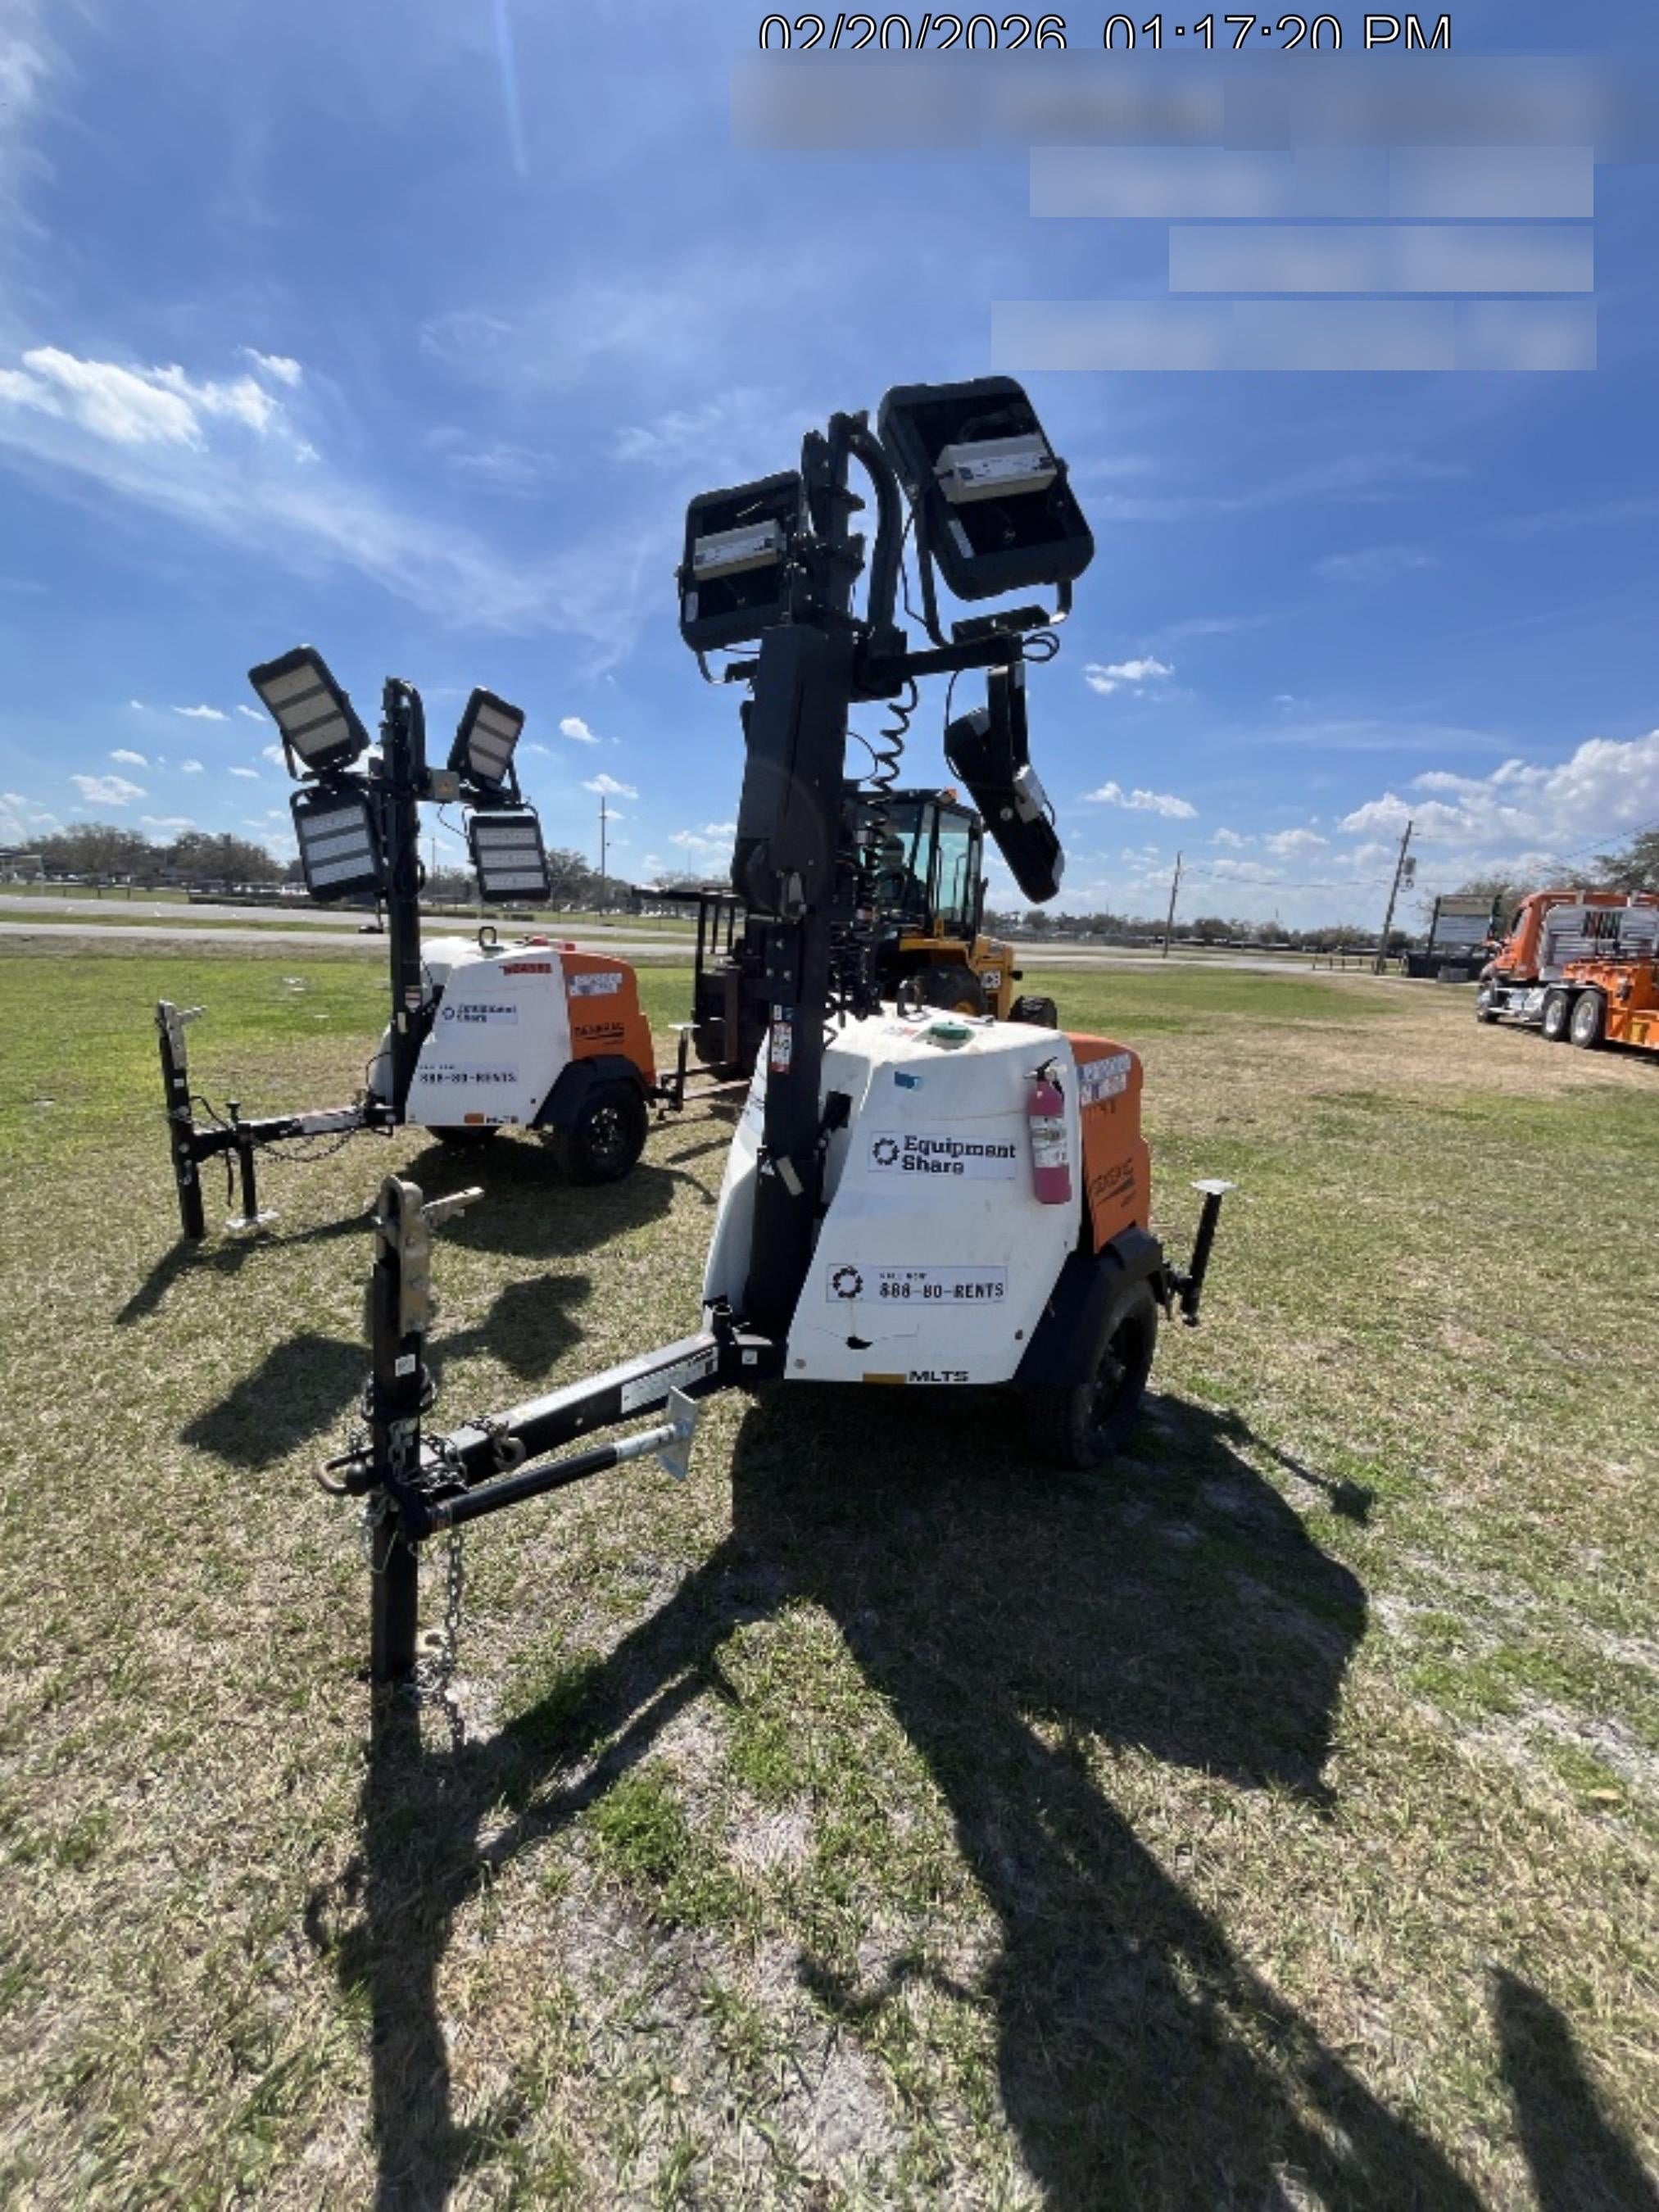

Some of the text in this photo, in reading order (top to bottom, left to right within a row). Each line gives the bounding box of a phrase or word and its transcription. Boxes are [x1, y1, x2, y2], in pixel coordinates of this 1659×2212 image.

[904, 1135, 1016, 1158] Equipment
[901, 1154, 965, 1175] Share
[909, 1371, 970, 1383] MLTS
